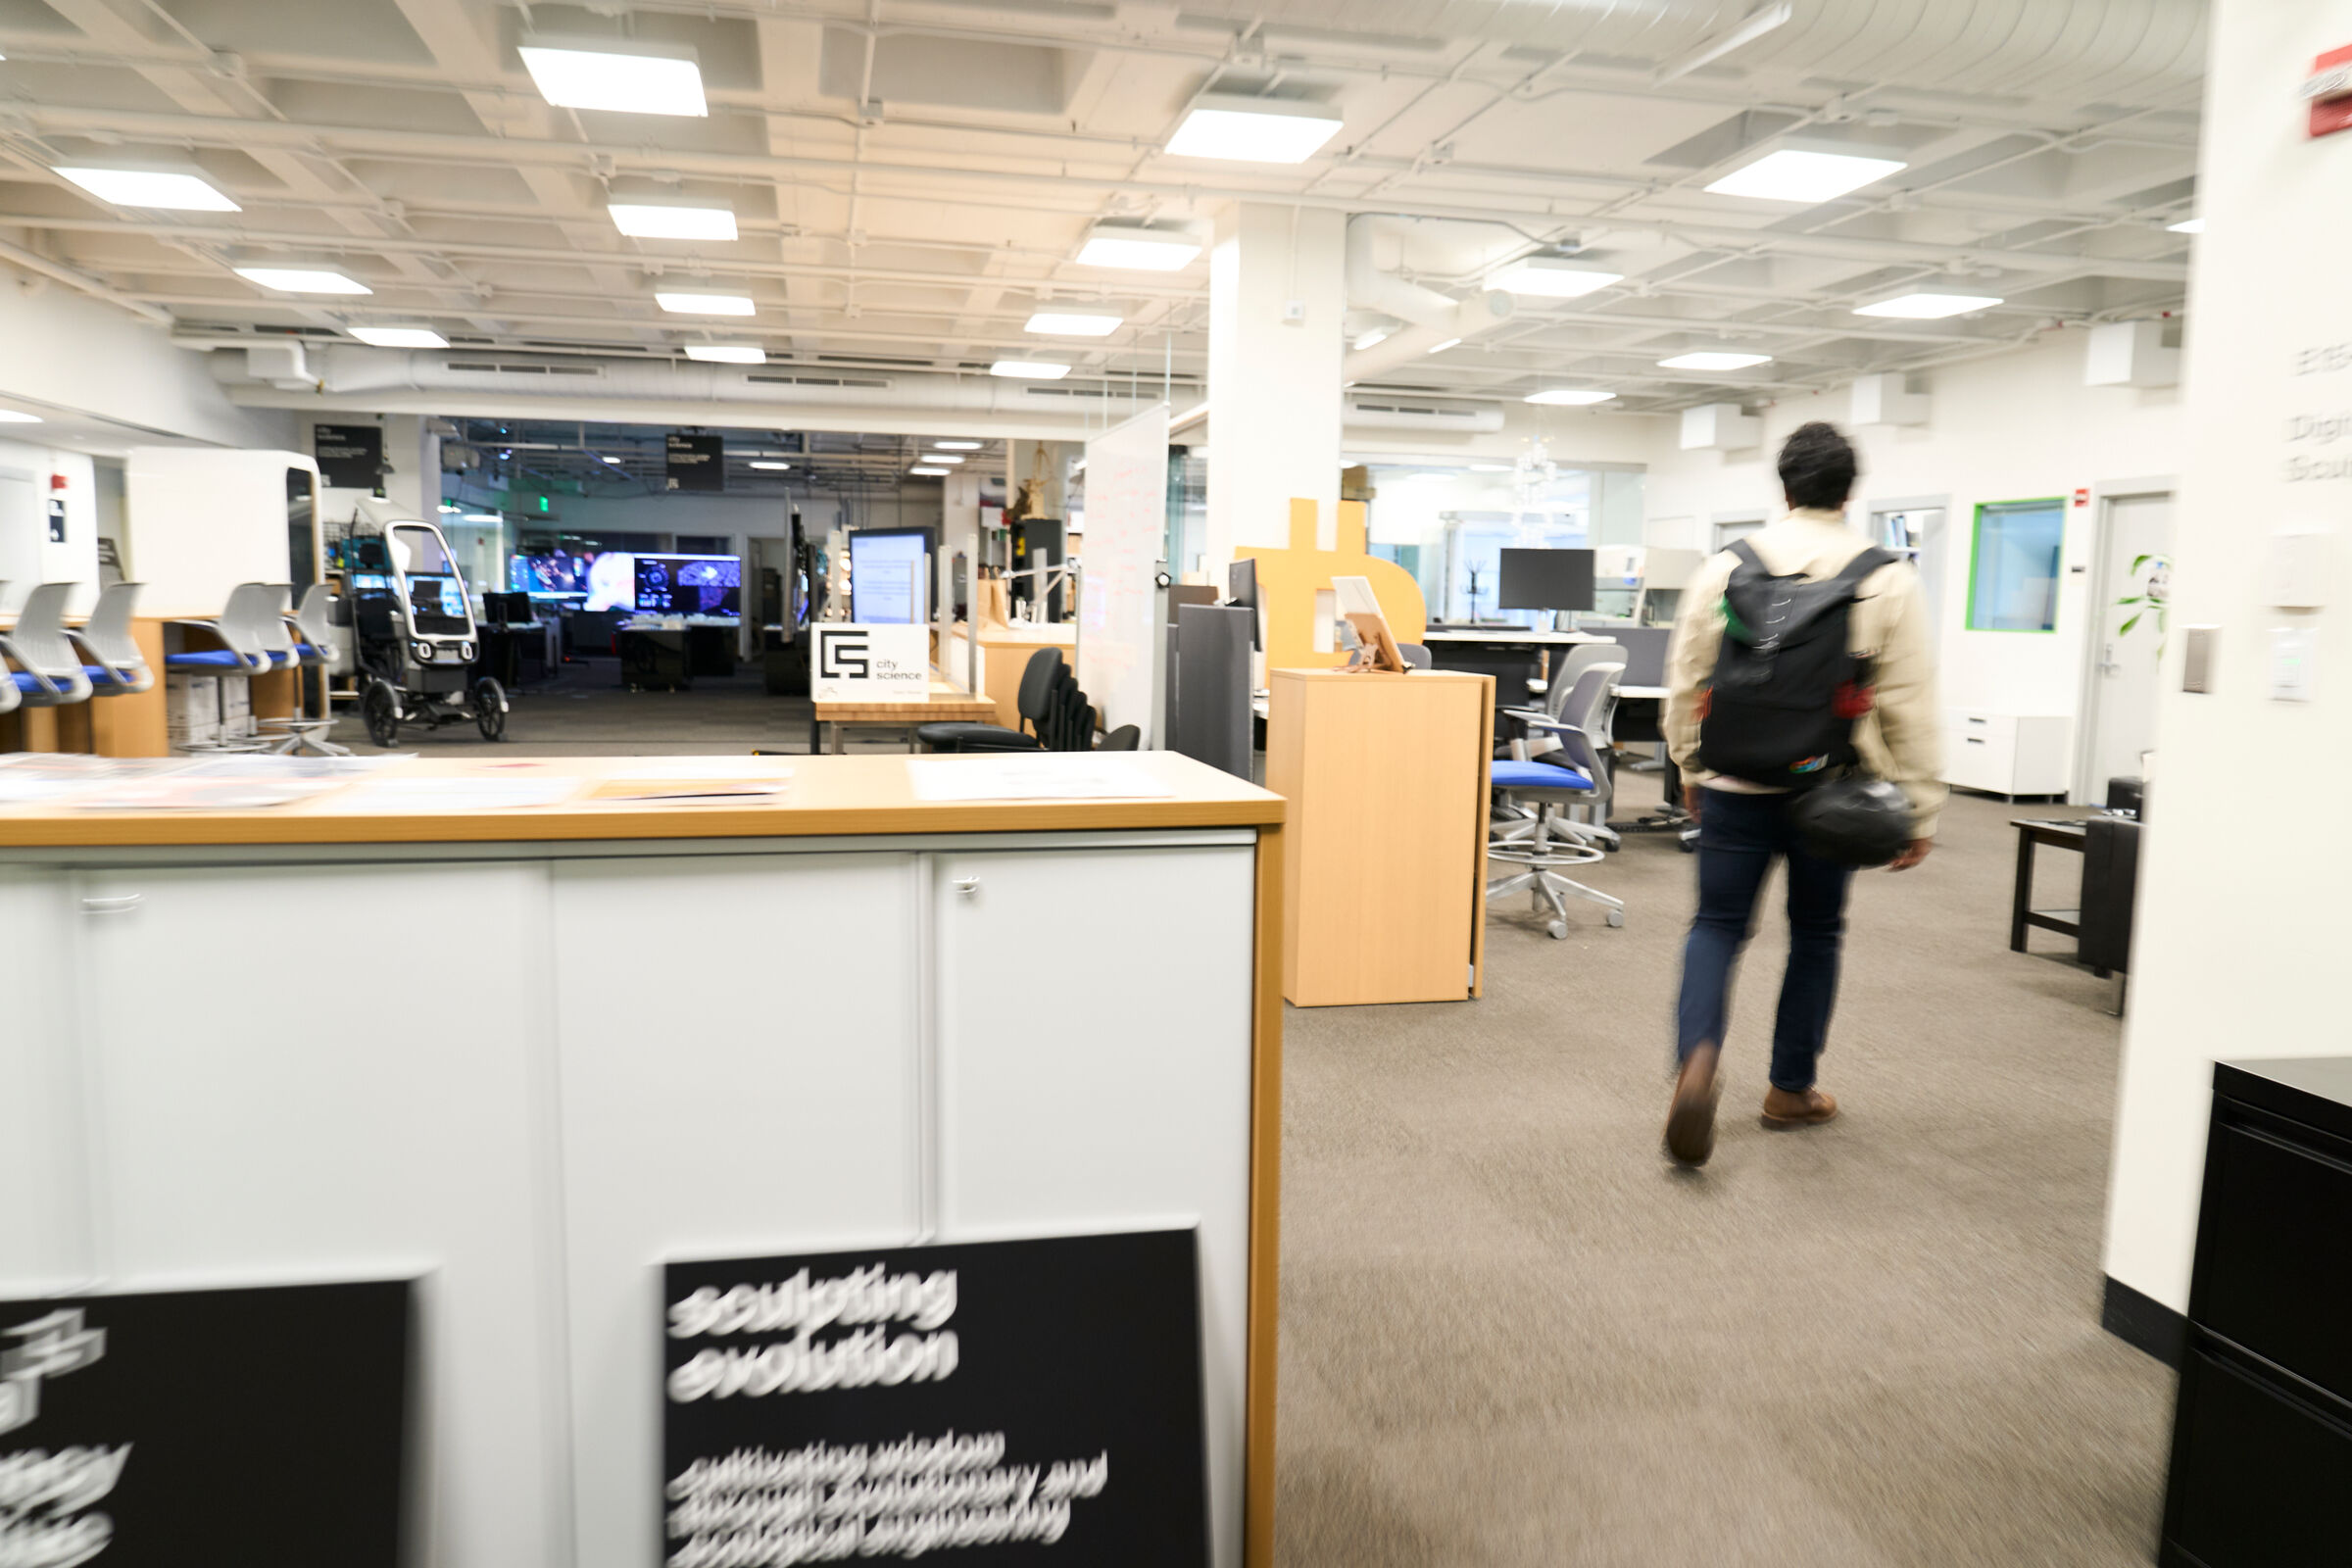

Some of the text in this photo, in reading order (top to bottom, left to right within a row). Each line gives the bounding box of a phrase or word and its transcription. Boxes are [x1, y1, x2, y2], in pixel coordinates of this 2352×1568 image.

[876, 659, 898, 670] city
[876, 671, 922, 680] science
[667, 1262, 957, 1339] sculpting
[667, 1327, 958, 1403] evolution
[1036, 1448, 1108, 1498] and
[859, 1496, 1071, 1560] engineering
